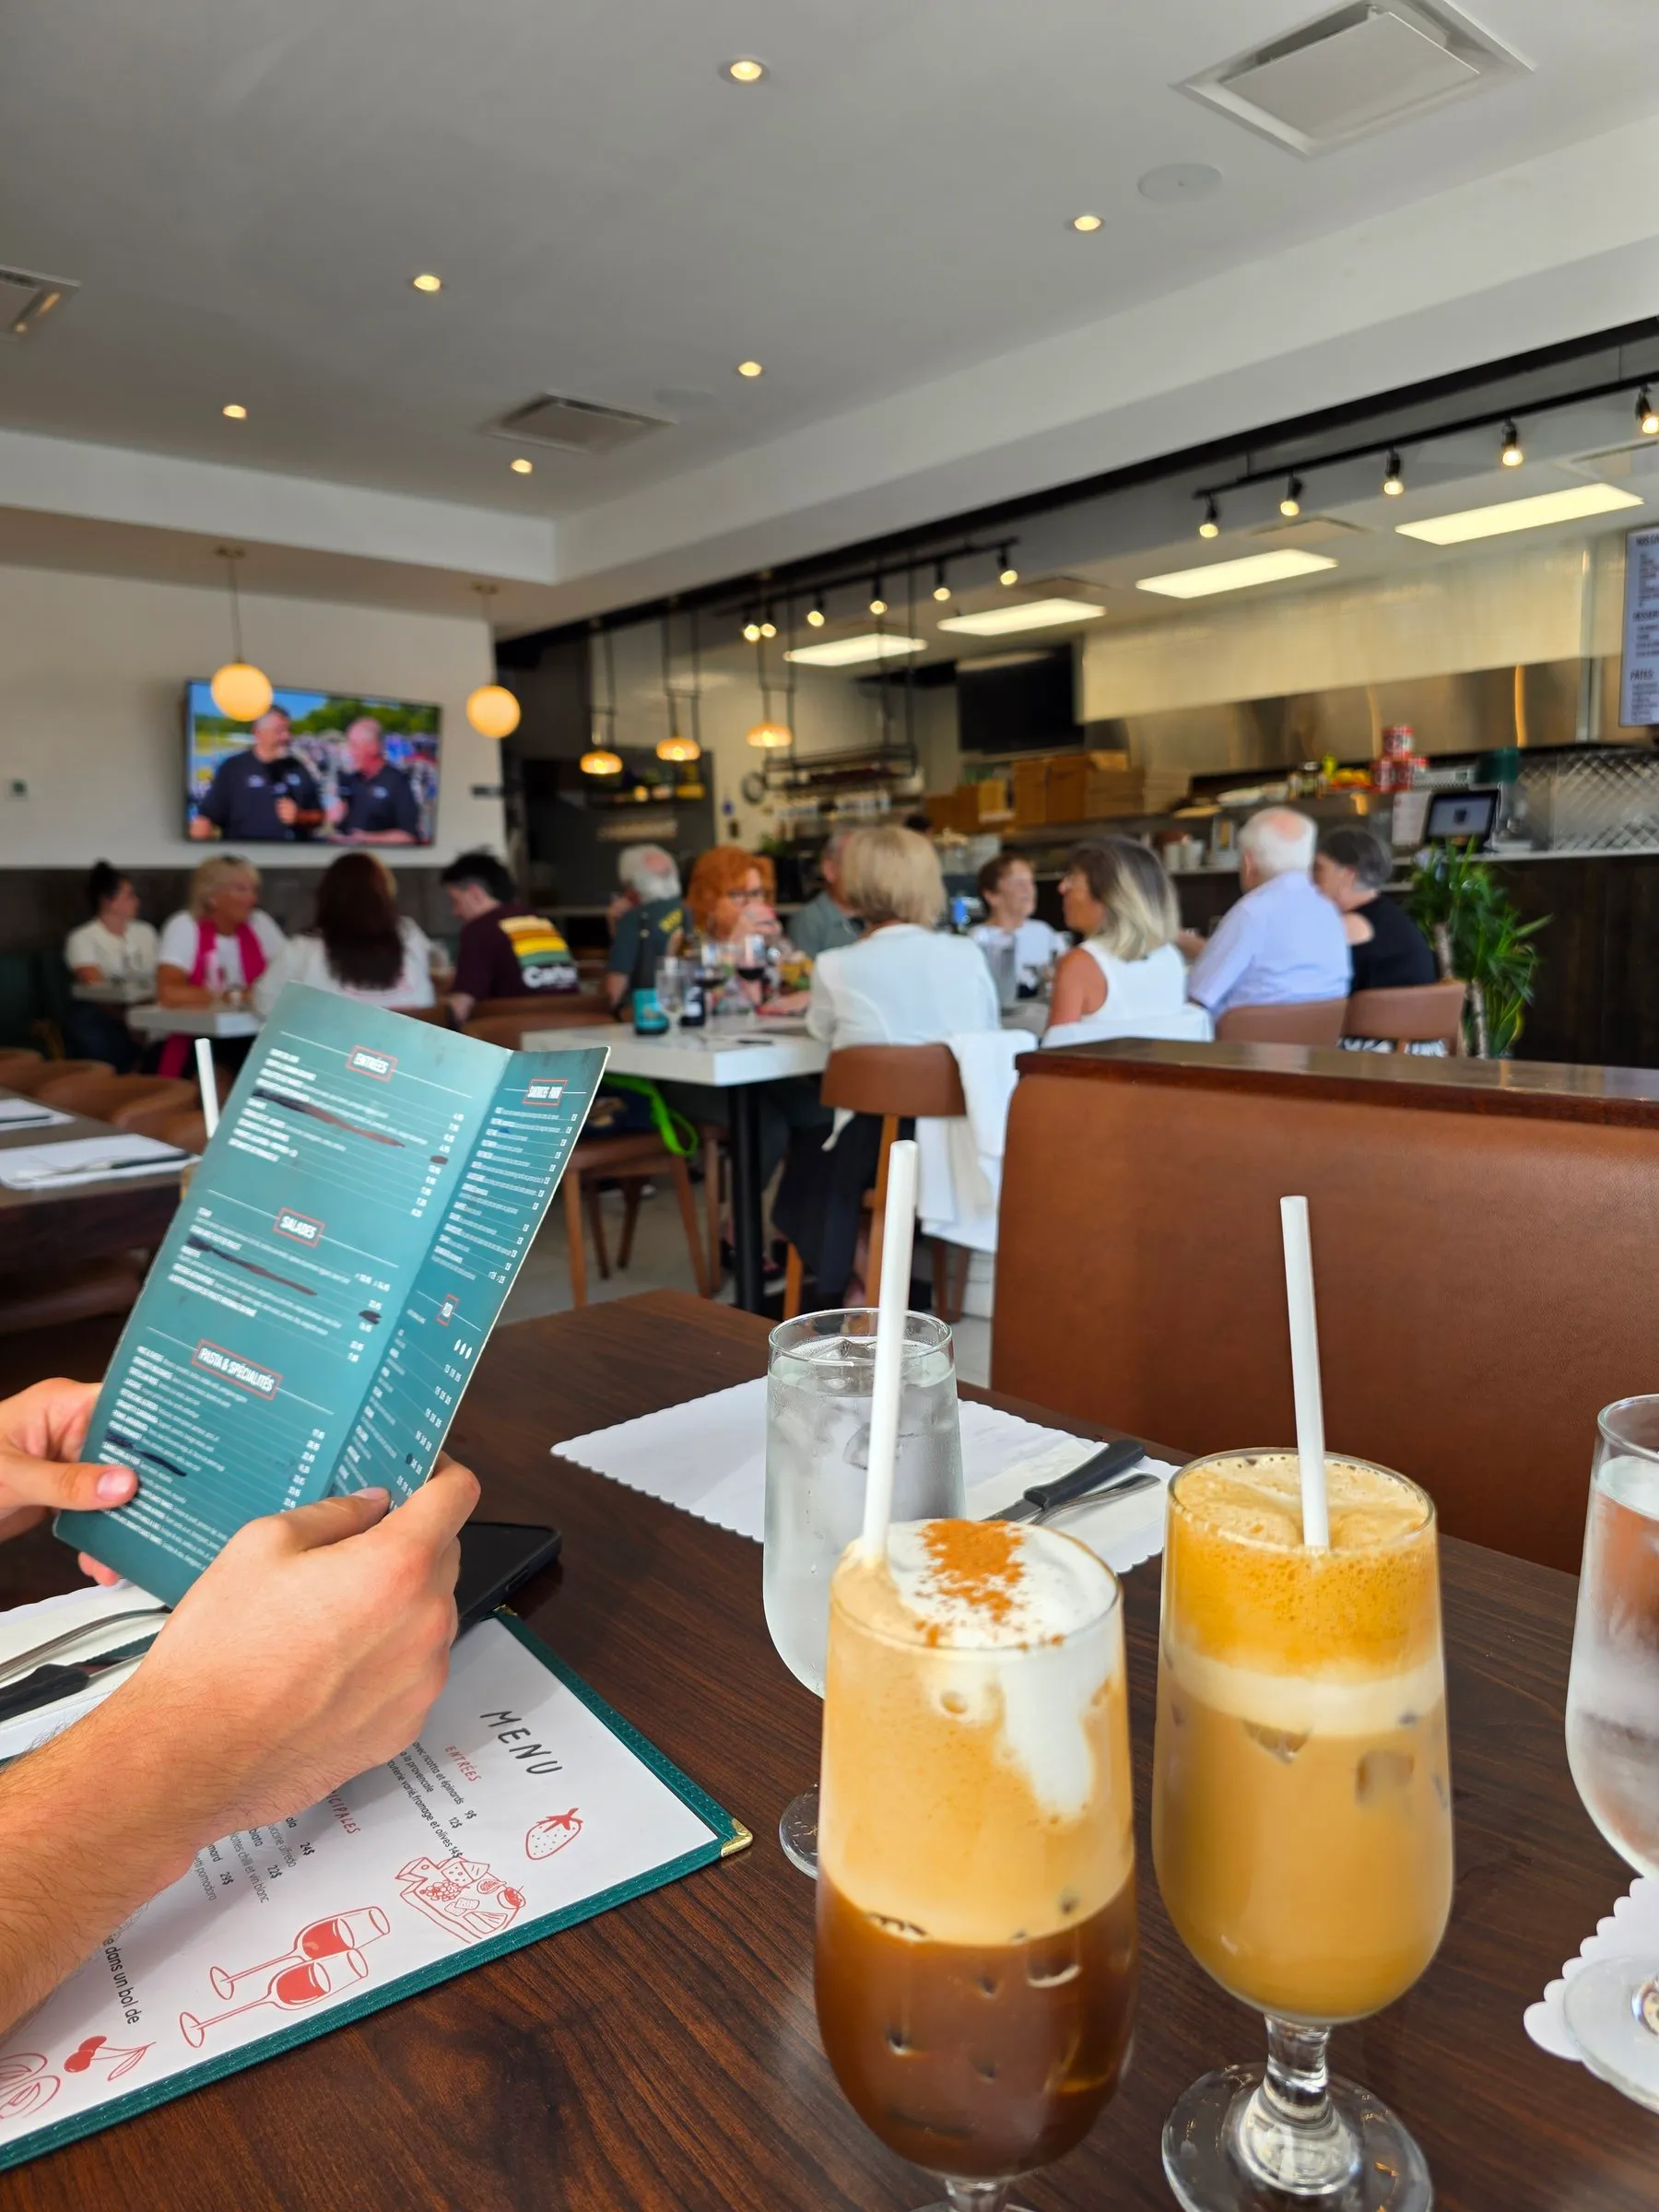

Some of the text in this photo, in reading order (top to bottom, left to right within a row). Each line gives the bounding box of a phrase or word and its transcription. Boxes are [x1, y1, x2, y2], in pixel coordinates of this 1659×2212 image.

[279, 1216, 317, 1240] SALADES
[197, 1347, 224, 1369] PASTA
[227, 1361, 275, 1393] SPÉCIALITÉS
[479, 1711, 563, 1774] MENU
[445, 1746, 482, 1782] ENTRÉES
[387, 1759, 405, 1781] cuterie
[429, 1820, 441, 1830] et
[435, 1829, 453, 1848] olives
[448, 1846, 464, 1858] 14$
[435, 1772, 446, 1781] et
[465, 1809, 477, 1819] 9$
[286, 1817, 315, 1856] ala 24$
[449, 1817, 463, 1829] 12$
[207, 1844, 234, 1886] mard 29$
[249, 1828, 283, 1879] biata 22$
[194, 1867, 217, 1901] pomodoro
[244, 1865, 255, 1874] et
[254, 1882, 269, 1903] blanc
[104, 1946, 124, 1972] dans
[112, 1971, 128, 1988] un
[118, 1986, 139, 2008] bol
[124, 2008, 143, 2025] de
